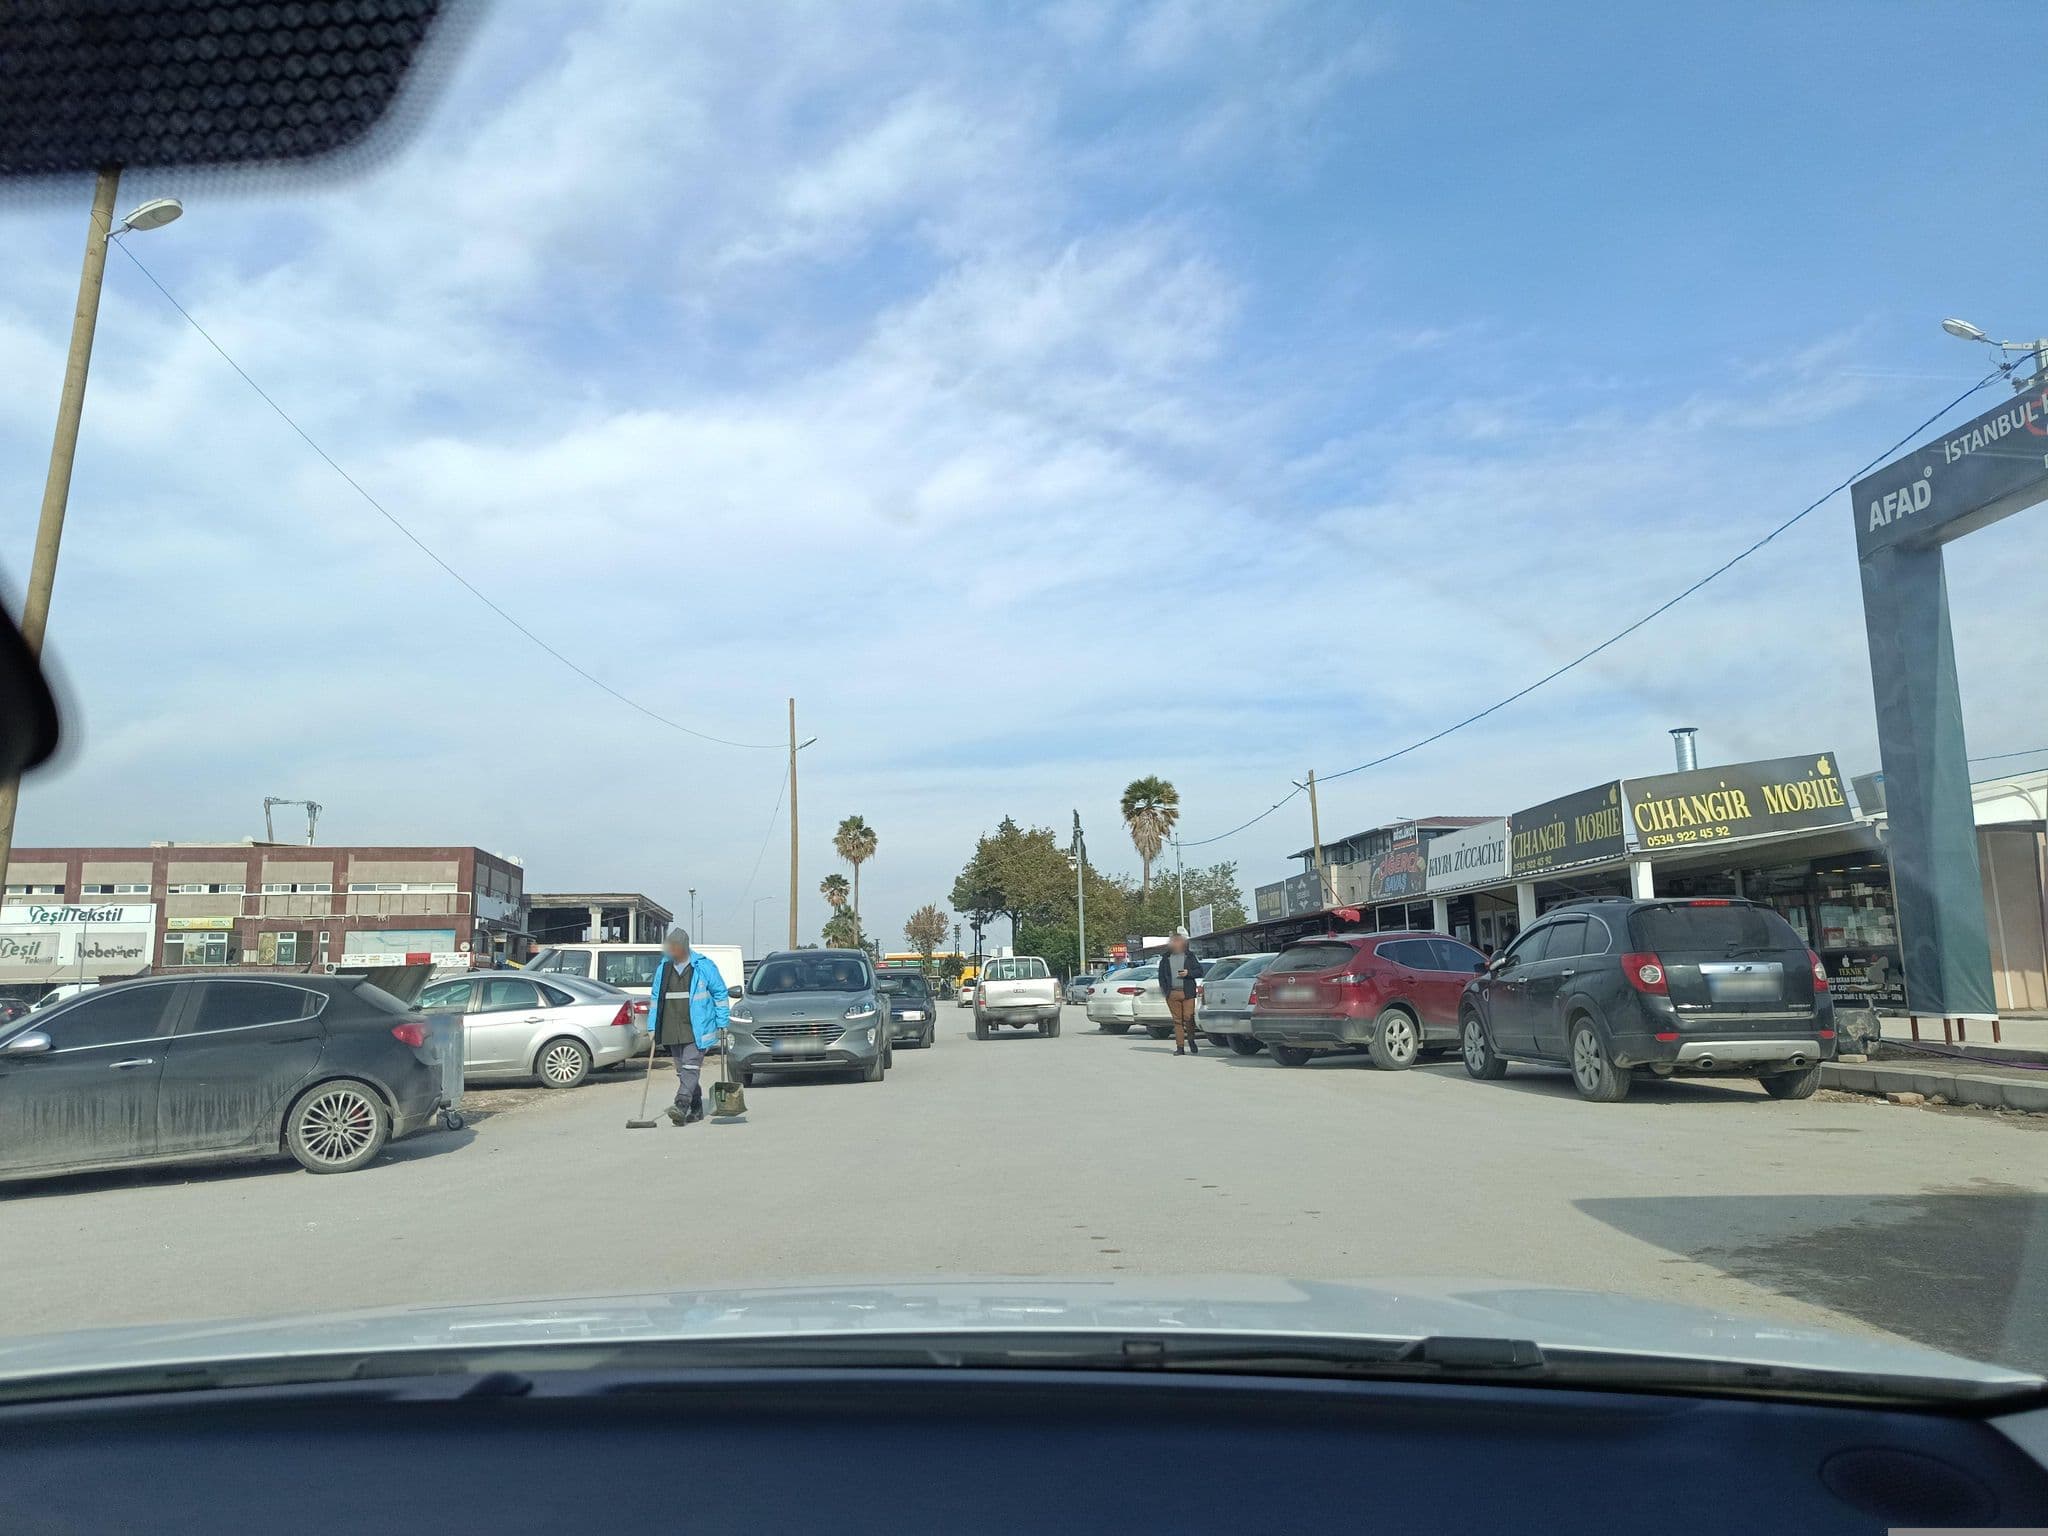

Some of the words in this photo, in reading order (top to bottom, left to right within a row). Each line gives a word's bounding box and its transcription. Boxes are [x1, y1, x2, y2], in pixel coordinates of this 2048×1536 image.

[1944, 401, 2039, 464] İSTANBUL
[1869, 479, 1932, 532] AFAD
[1634, 781, 1751, 832] CİHANGİR
[1647, 834, 1674, 847] 0534
[1677, 830, 1698, 842] 922
[1700, 827, 1714, 840] 45
[1717, 825, 1730, 837] 92
